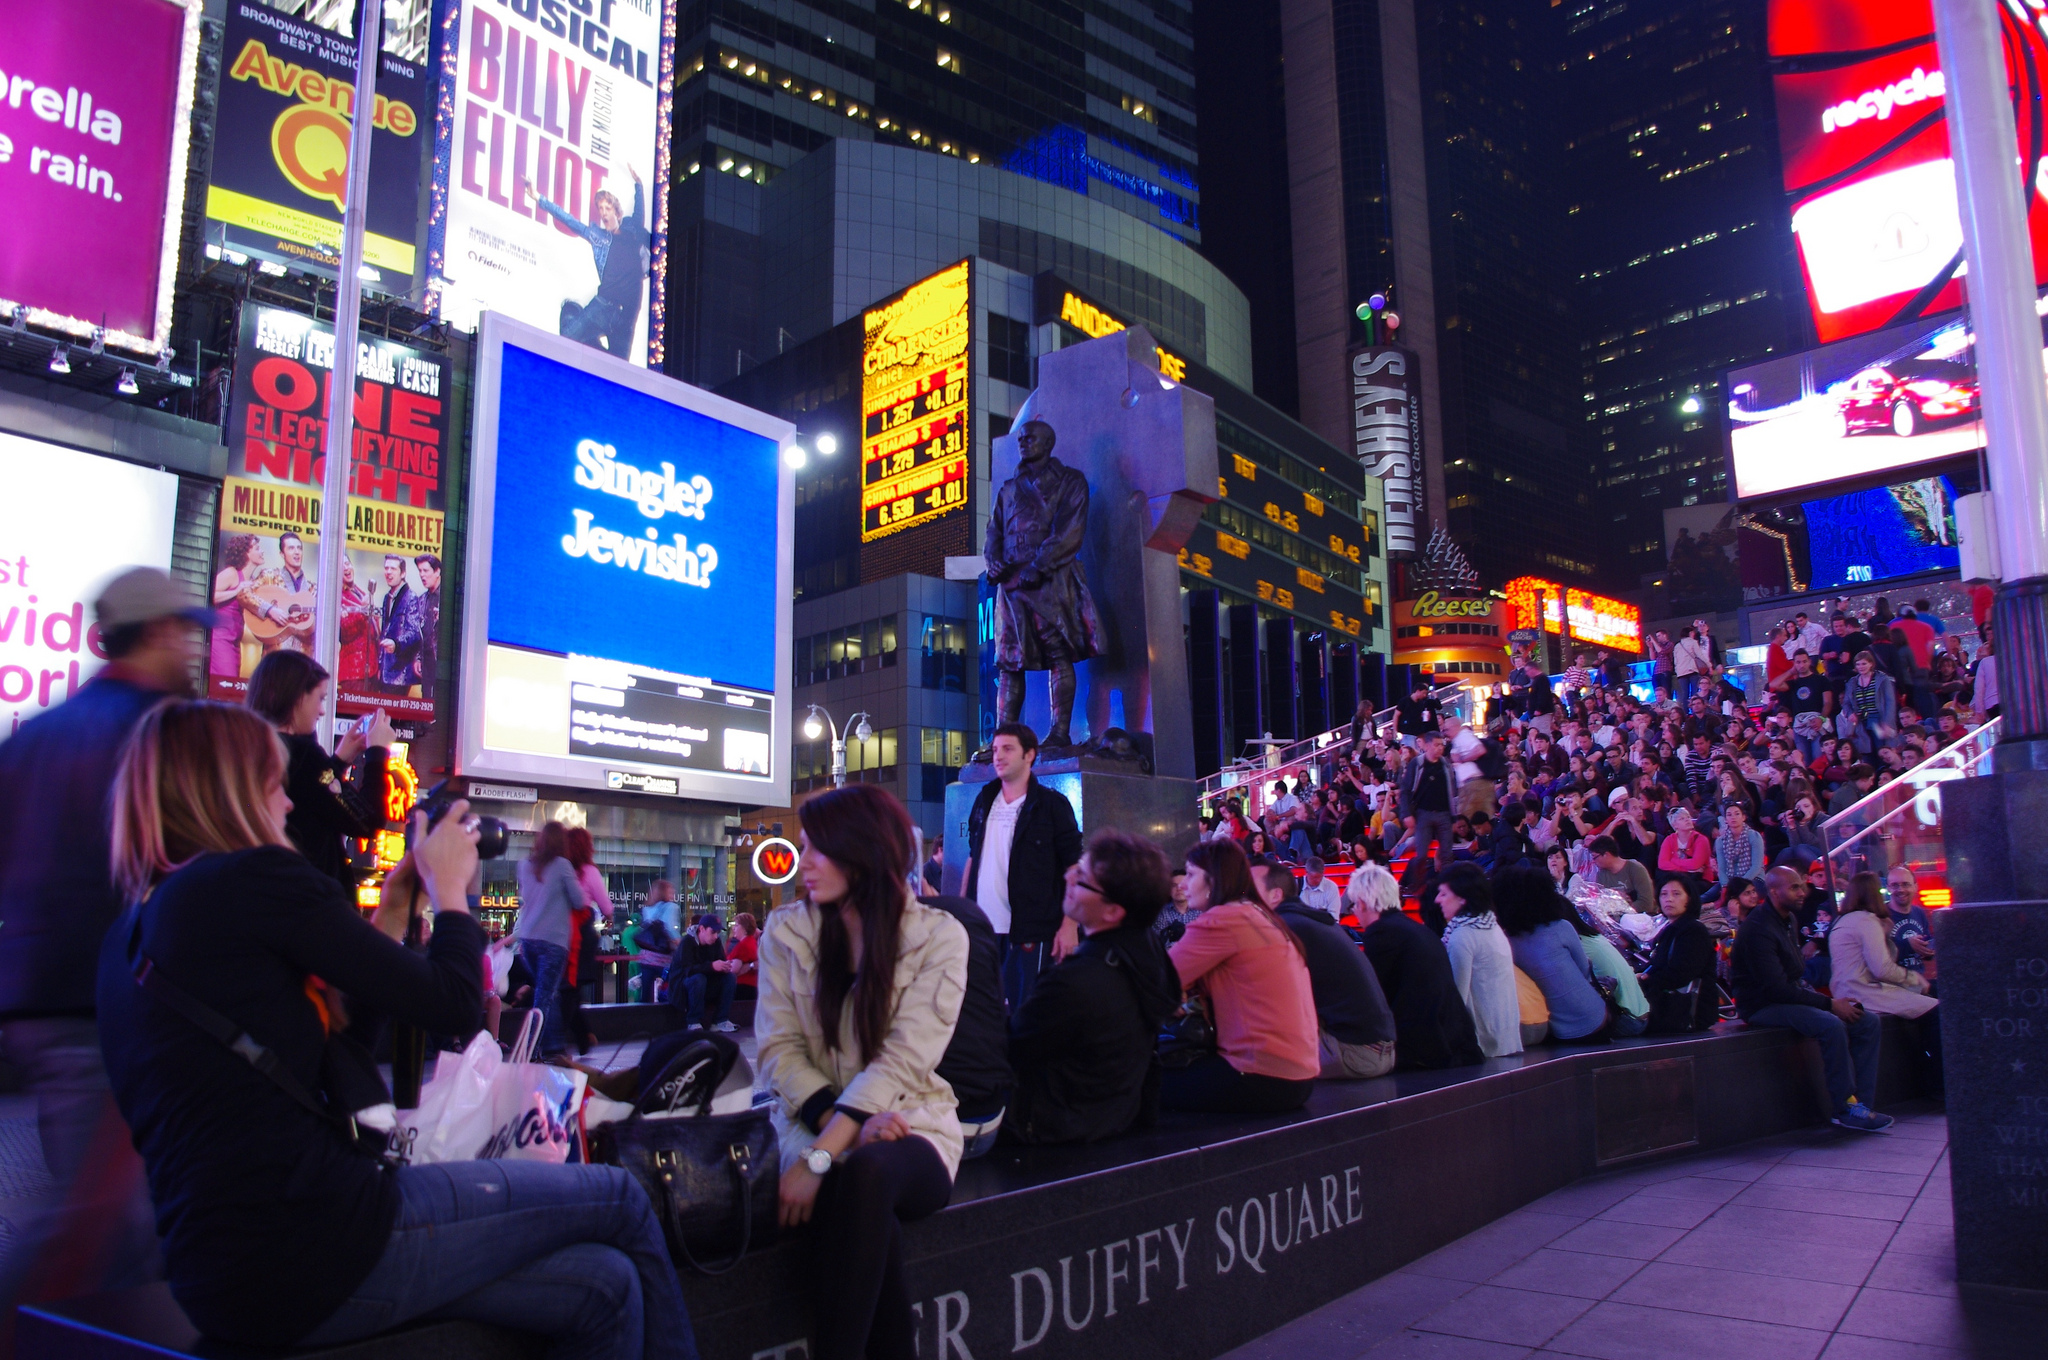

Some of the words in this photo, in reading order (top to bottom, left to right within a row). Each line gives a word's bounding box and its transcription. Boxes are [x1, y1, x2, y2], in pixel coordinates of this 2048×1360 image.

[240, 5, 322, 45] BROADWAY'S
[325, 37, 357, 58] TONY
[279, 32, 315, 54] BEST
[319, 47, 360, 71] MUSIC
[467, 4, 592, 148] BILLY
[592, 74, 614, 136] MUSICAL
[271, 103, 354, 215] Q
[590, 133, 611, 161] THE
[30, 146, 122, 202] rain.
[461, 97, 609, 238] ELLIOT
[256, 335, 301, 361] PRESLEY
[357, 343, 395, 370] CARL
[403, 356, 441, 375] JOHNNY
[864, 311, 968, 376] CURRENCIES
[252, 356, 442, 446] ONE
[402, 369, 440, 397] CASH
[866, 382, 918, 415] SINGAPORE
[881, 400, 915, 431] 1.257
[925, 380, 962, 411] +0.07
[245, 402, 440, 478] ELECTIFYING
[1409, 395, 1422, 474] Chocolate
[574, 439, 713, 520] Single?
[881, 447, 915, 478] 1.279
[866, 485, 897, 508] CHINA
[1412, 475, 1424, 513] Milk
[232, 515, 303, 534] INSPIRED
[359, 534, 395, 548] TRUE
[397, 540, 441, 554] STORY
[561, 508, 719, 589] Jewish?
[1412, 591, 1494, 618] Reese's
[344, 693, 393, 708] Ticketmaster.com
[400, 699, 434, 712] 877-250-2929
[482, 789, 505, 798] ADOBE
[506, 790, 527, 800] FLASH
[763, 850, 794, 875] W
[608, 891, 632, 901] BLUE
[634, 892, 649, 901] FIN
[687, 894, 700, 903] FIN
[713, 894, 735, 904] BLUE
[1980, 1017, 2034, 1038] FOR
[1215, 1166, 1364, 1275] SQUARE
[1011, 1217, 1196, 1354] DUFFY
